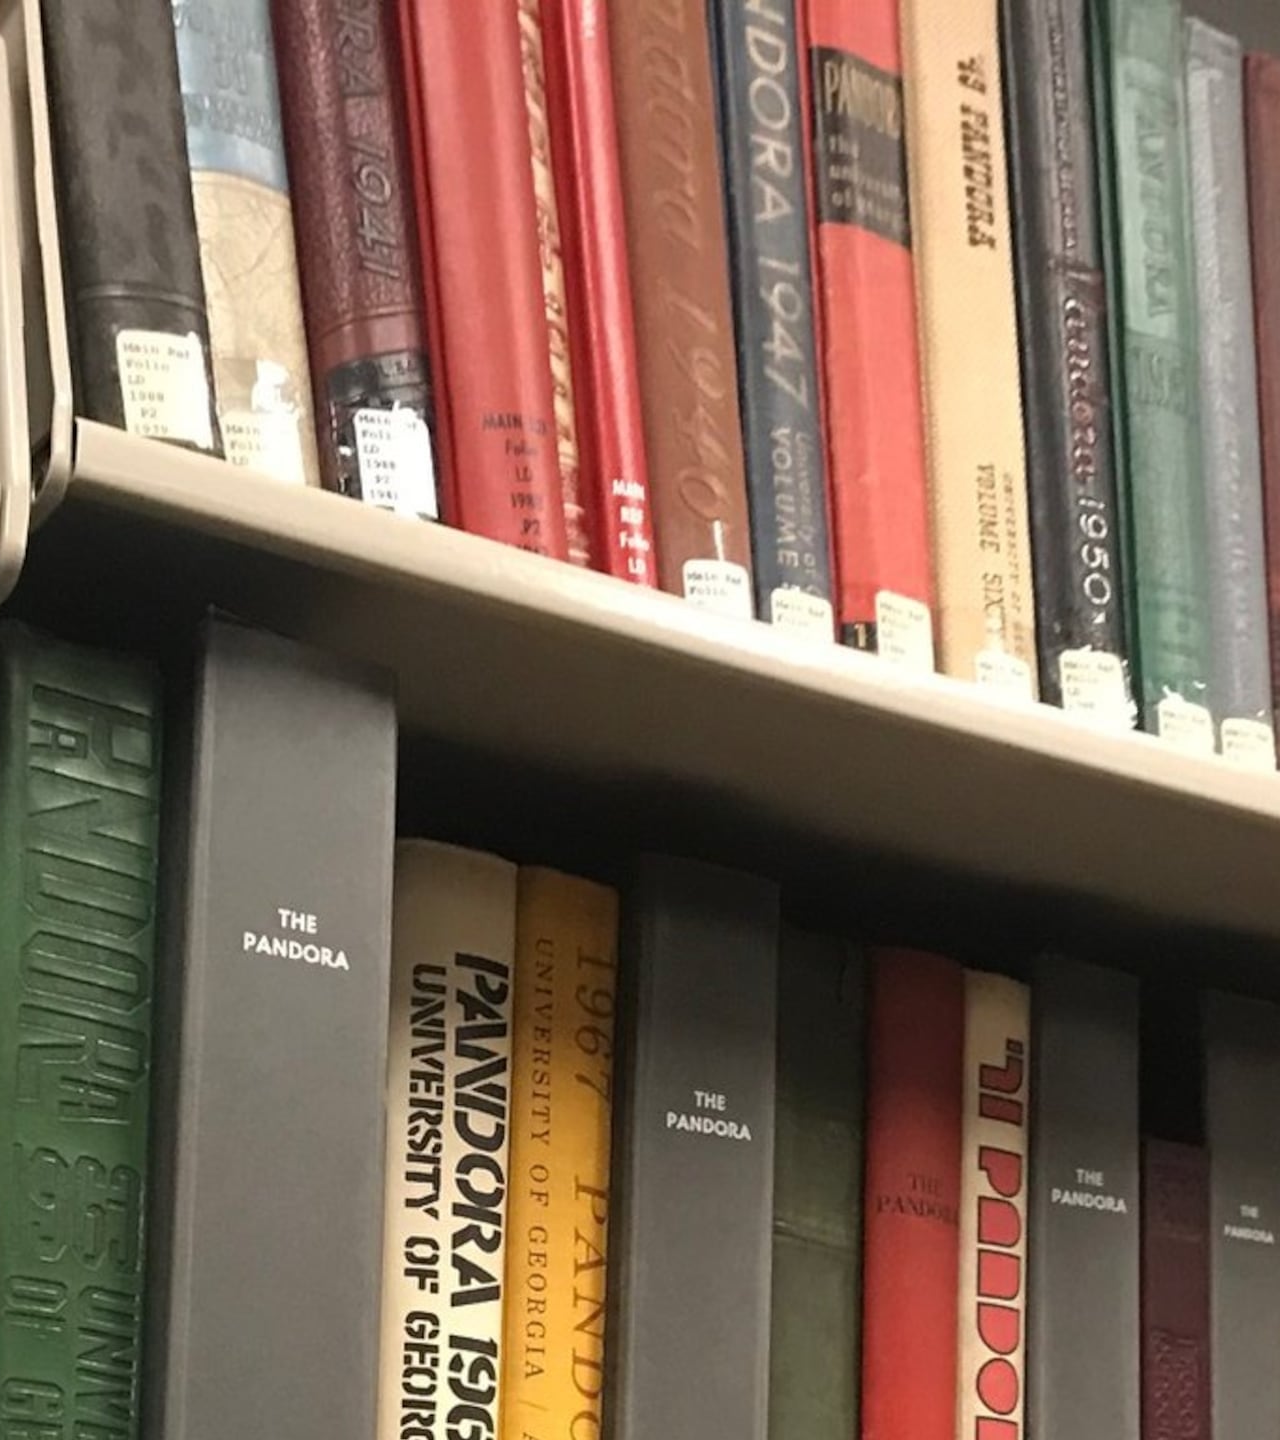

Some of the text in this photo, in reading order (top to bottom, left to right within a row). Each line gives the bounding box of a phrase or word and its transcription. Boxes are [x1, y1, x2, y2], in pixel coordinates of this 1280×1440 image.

[758, 256, 808, 412] 1947
[278, 908, 318, 934] THE
[243, 932, 350, 970] PANDORA
[531, 939, 554, 1145] UNIVERSITY
[573, 946, 616, 1098] 1967
[404, 963, 446, 1221] UNIVERSITY
[695, 1090, 726, 1111] THE
[450, 952, 510, 1309] PANDORA
[666, 1112, 752, 1142] PANDORA
[528, 1164, 550, 1207] OF
[1051, 1188, 1127, 1214] PANDORA
[1076, 1169, 1104, 1186] THE
[404, 1235, 440, 1295] OF
[524, 1226, 549, 1379] GEORGIA
